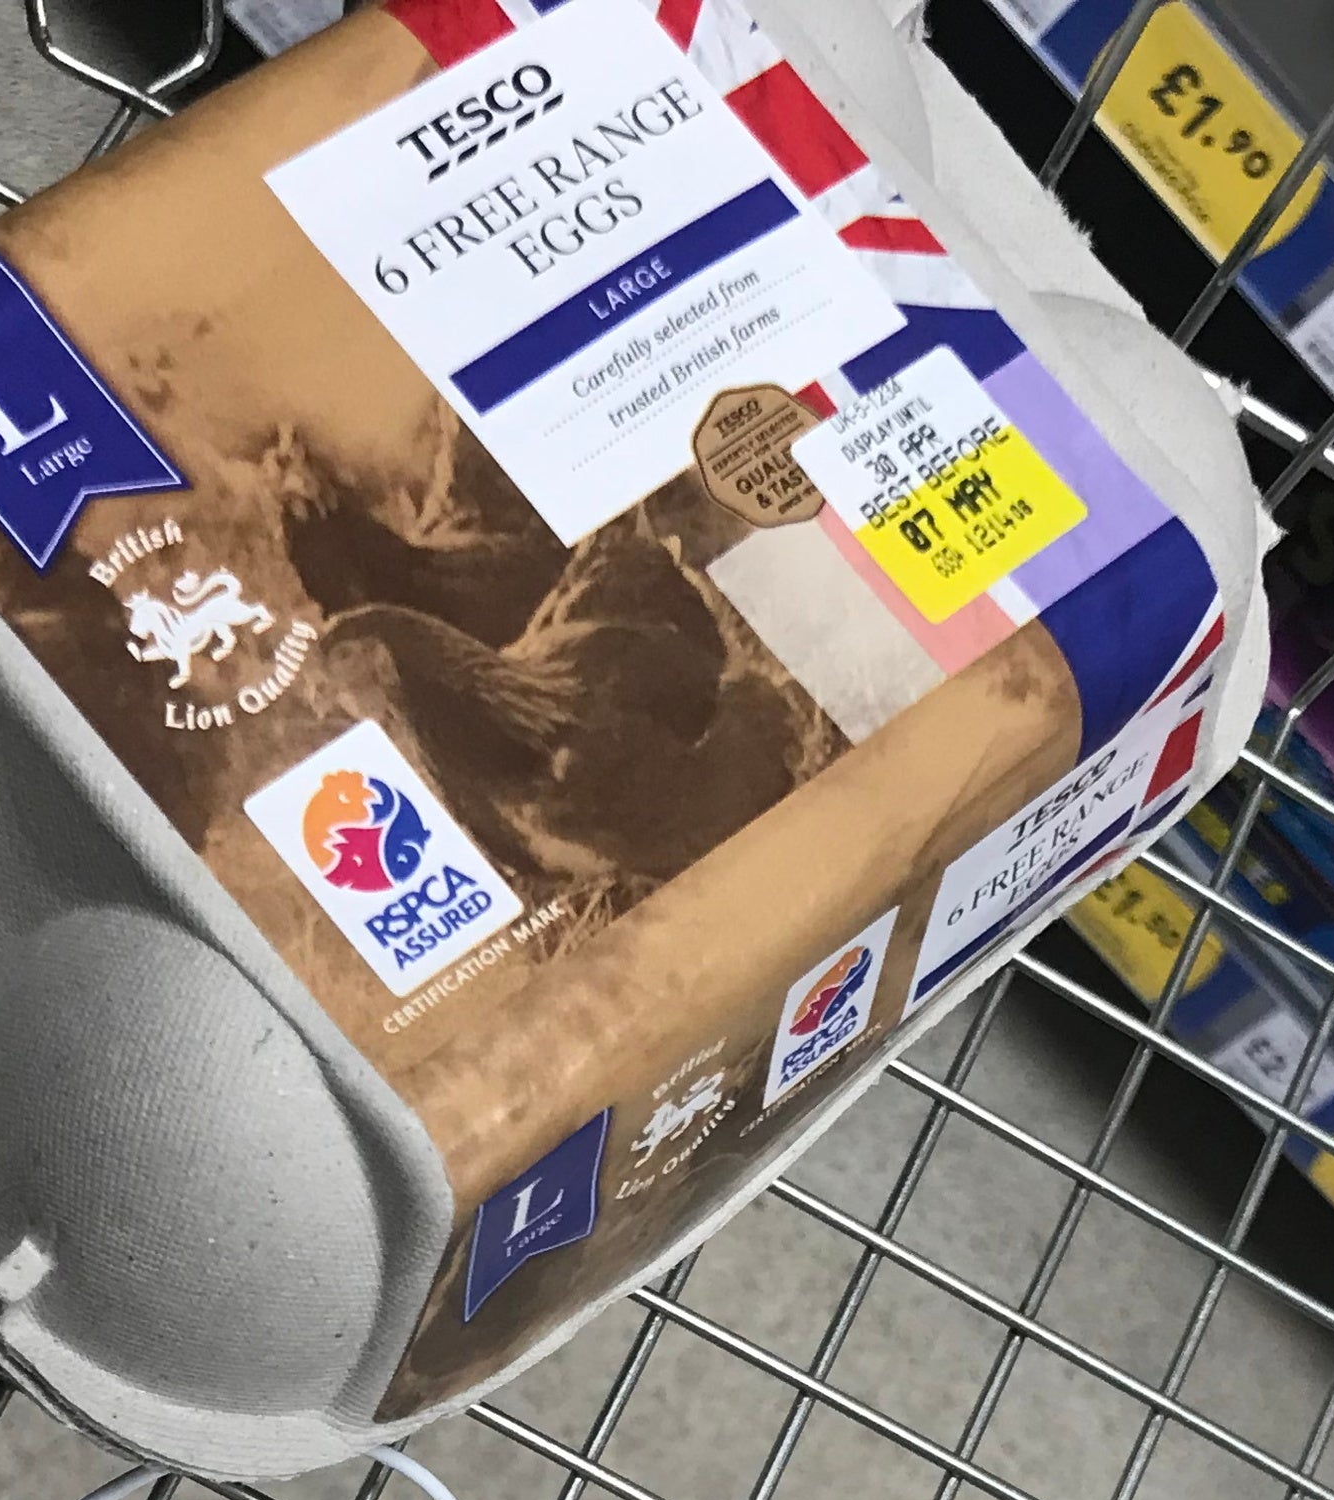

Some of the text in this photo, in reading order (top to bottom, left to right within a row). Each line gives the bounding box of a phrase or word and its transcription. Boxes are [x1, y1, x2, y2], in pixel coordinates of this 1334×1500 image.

[396, 62, 553, 165] TESCO
[1148, 63, 1272, 179] £1.90
[374, 76, 704, 297] 6 FREE RANGE
[508, 178, 644, 280] EGGS
[588, 255, 672, 320] LARGE
[572, 271, 760, 398] Carefully selected from
[608, 307, 780, 429] trusted British farms
[18, 435, 93, 488] Large
[714, 399, 760, 438] TESCO
[841, 397, 934, 463] DISPLAY UNTIL
[898, 424, 944, 464] APR
[767, 470, 804, 499] TAS
[859, 475, 921, 531] BEST
[917, 416, 1010, 490] BEFORE
[898, 467, 1002, 554] 07 MAY
[88, 518, 184, 588] British
[165, 619, 317, 731] Lion Quality
[1013, 749, 1118, 841] TESCO
[947, 900, 965, 926] 6
[970, 838, 1046, 912] FREE
[1051, 752, 1149, 848] RANGE
[365, 865, 478, 948] RSPCA
[393, 890, 492, 970] ASSURED
[383, 900, 567, 1034] CERTIFICATION MARK
[780, 1005, 859, 1075] RSPCA
[503, 1177, 564, 1244] L
